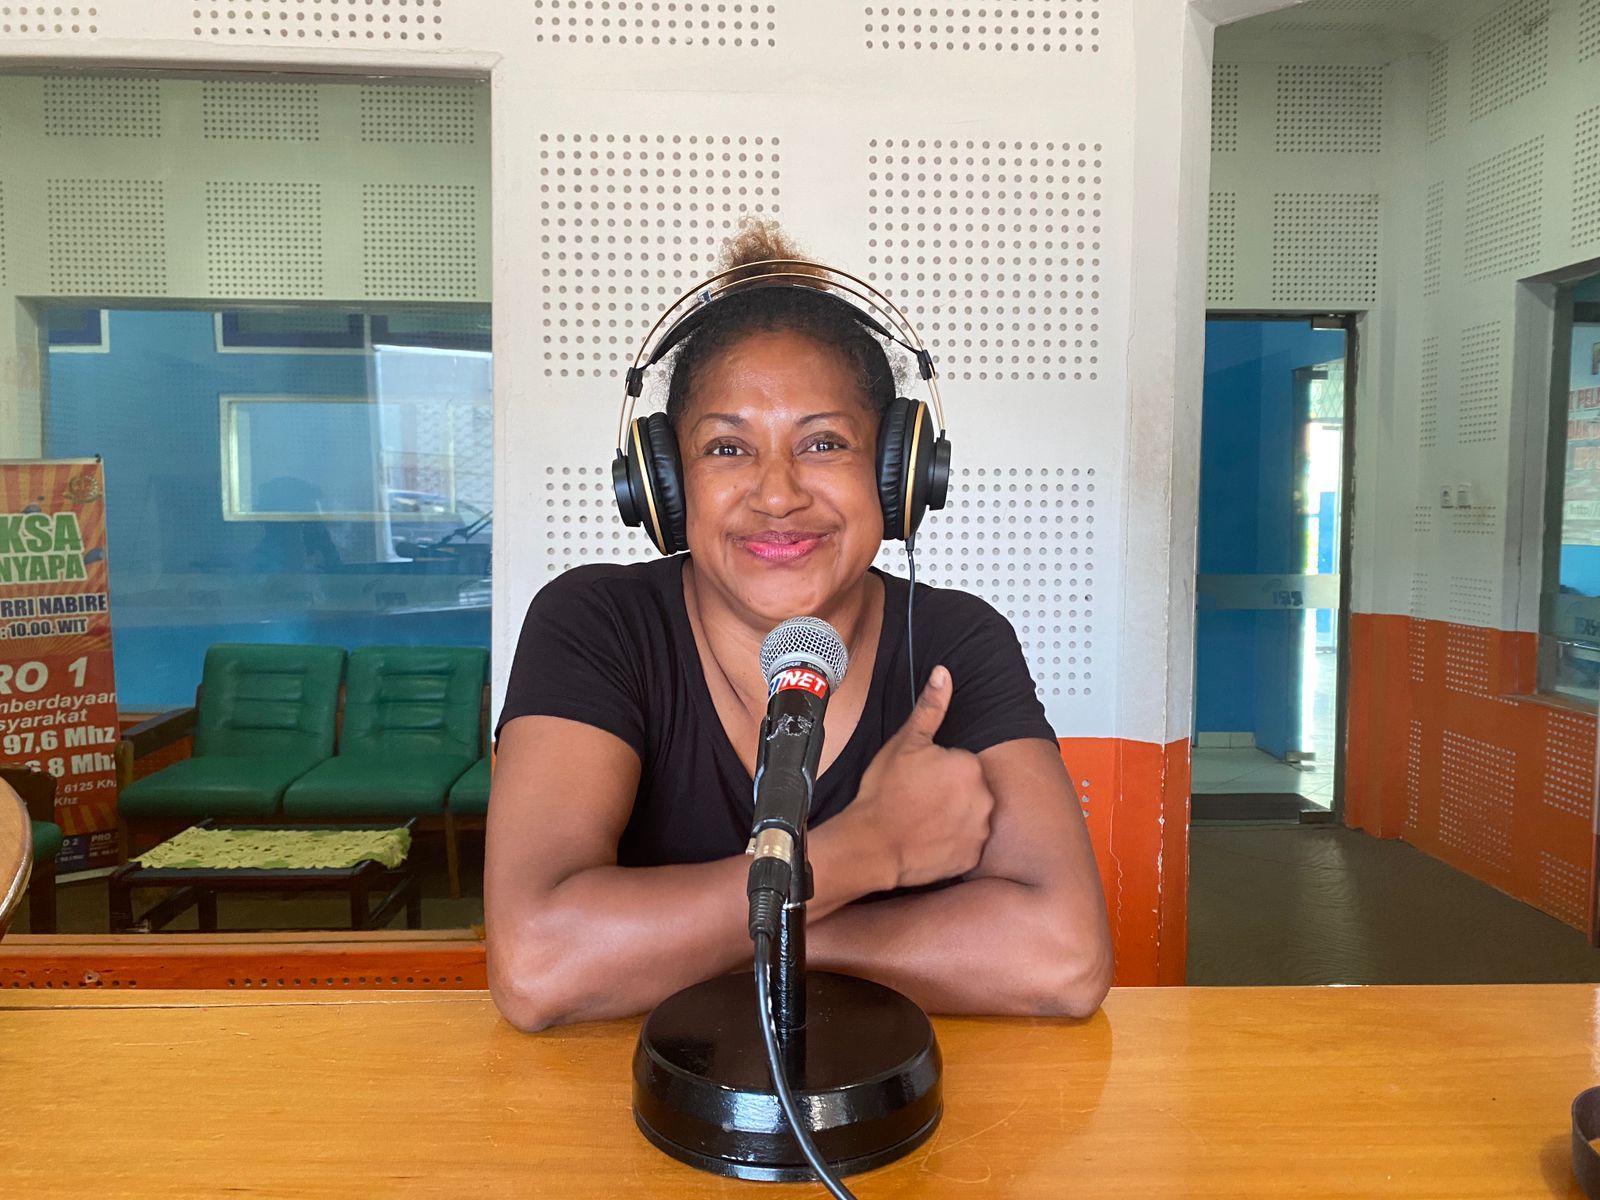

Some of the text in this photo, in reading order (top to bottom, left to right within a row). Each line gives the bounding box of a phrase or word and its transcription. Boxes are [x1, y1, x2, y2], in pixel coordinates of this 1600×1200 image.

[0, 513, 82, 553] KSA
[1, 595, 107, 617] RRI NABIRE
[57, 619, 87, 633] WIT
[68, 656, 88, 688] 1
[3, 725, 115, 755] 97,6 Mhz
[64, 781, 94, 793] 6125
